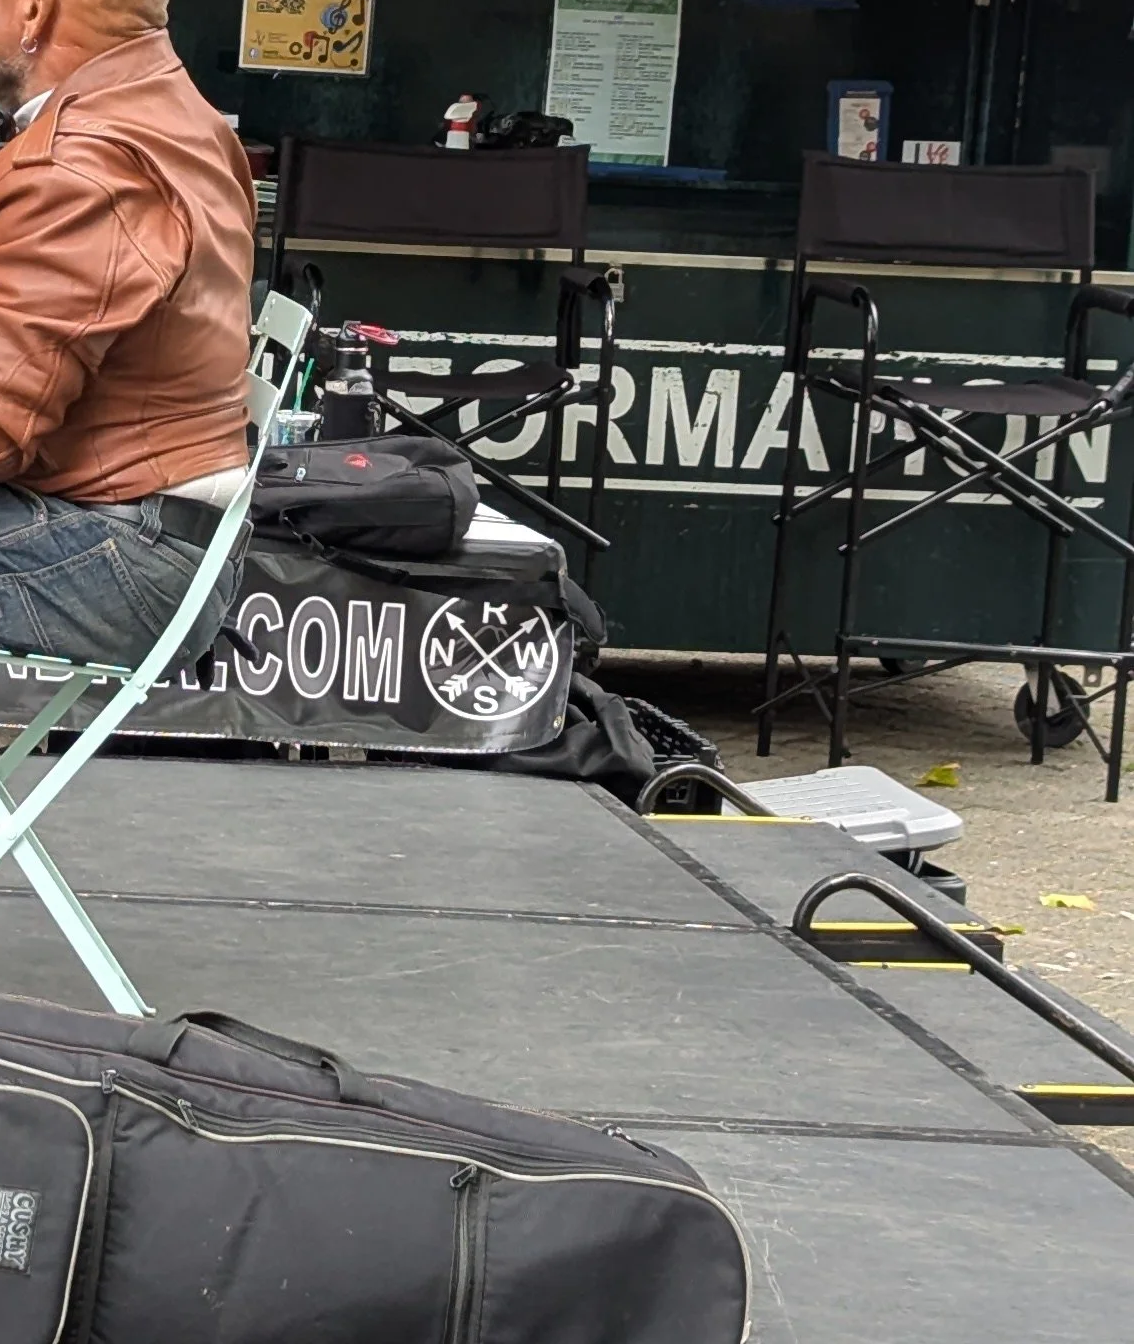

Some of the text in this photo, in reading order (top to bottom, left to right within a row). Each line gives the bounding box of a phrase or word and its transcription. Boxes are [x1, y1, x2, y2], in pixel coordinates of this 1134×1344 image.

[256, 353, 1112, 486] FORMAION
[429, 637, 549, 670] N W
[473, 686, 499, 714] S
[3, 1191, 36, 1271] CUSHY
